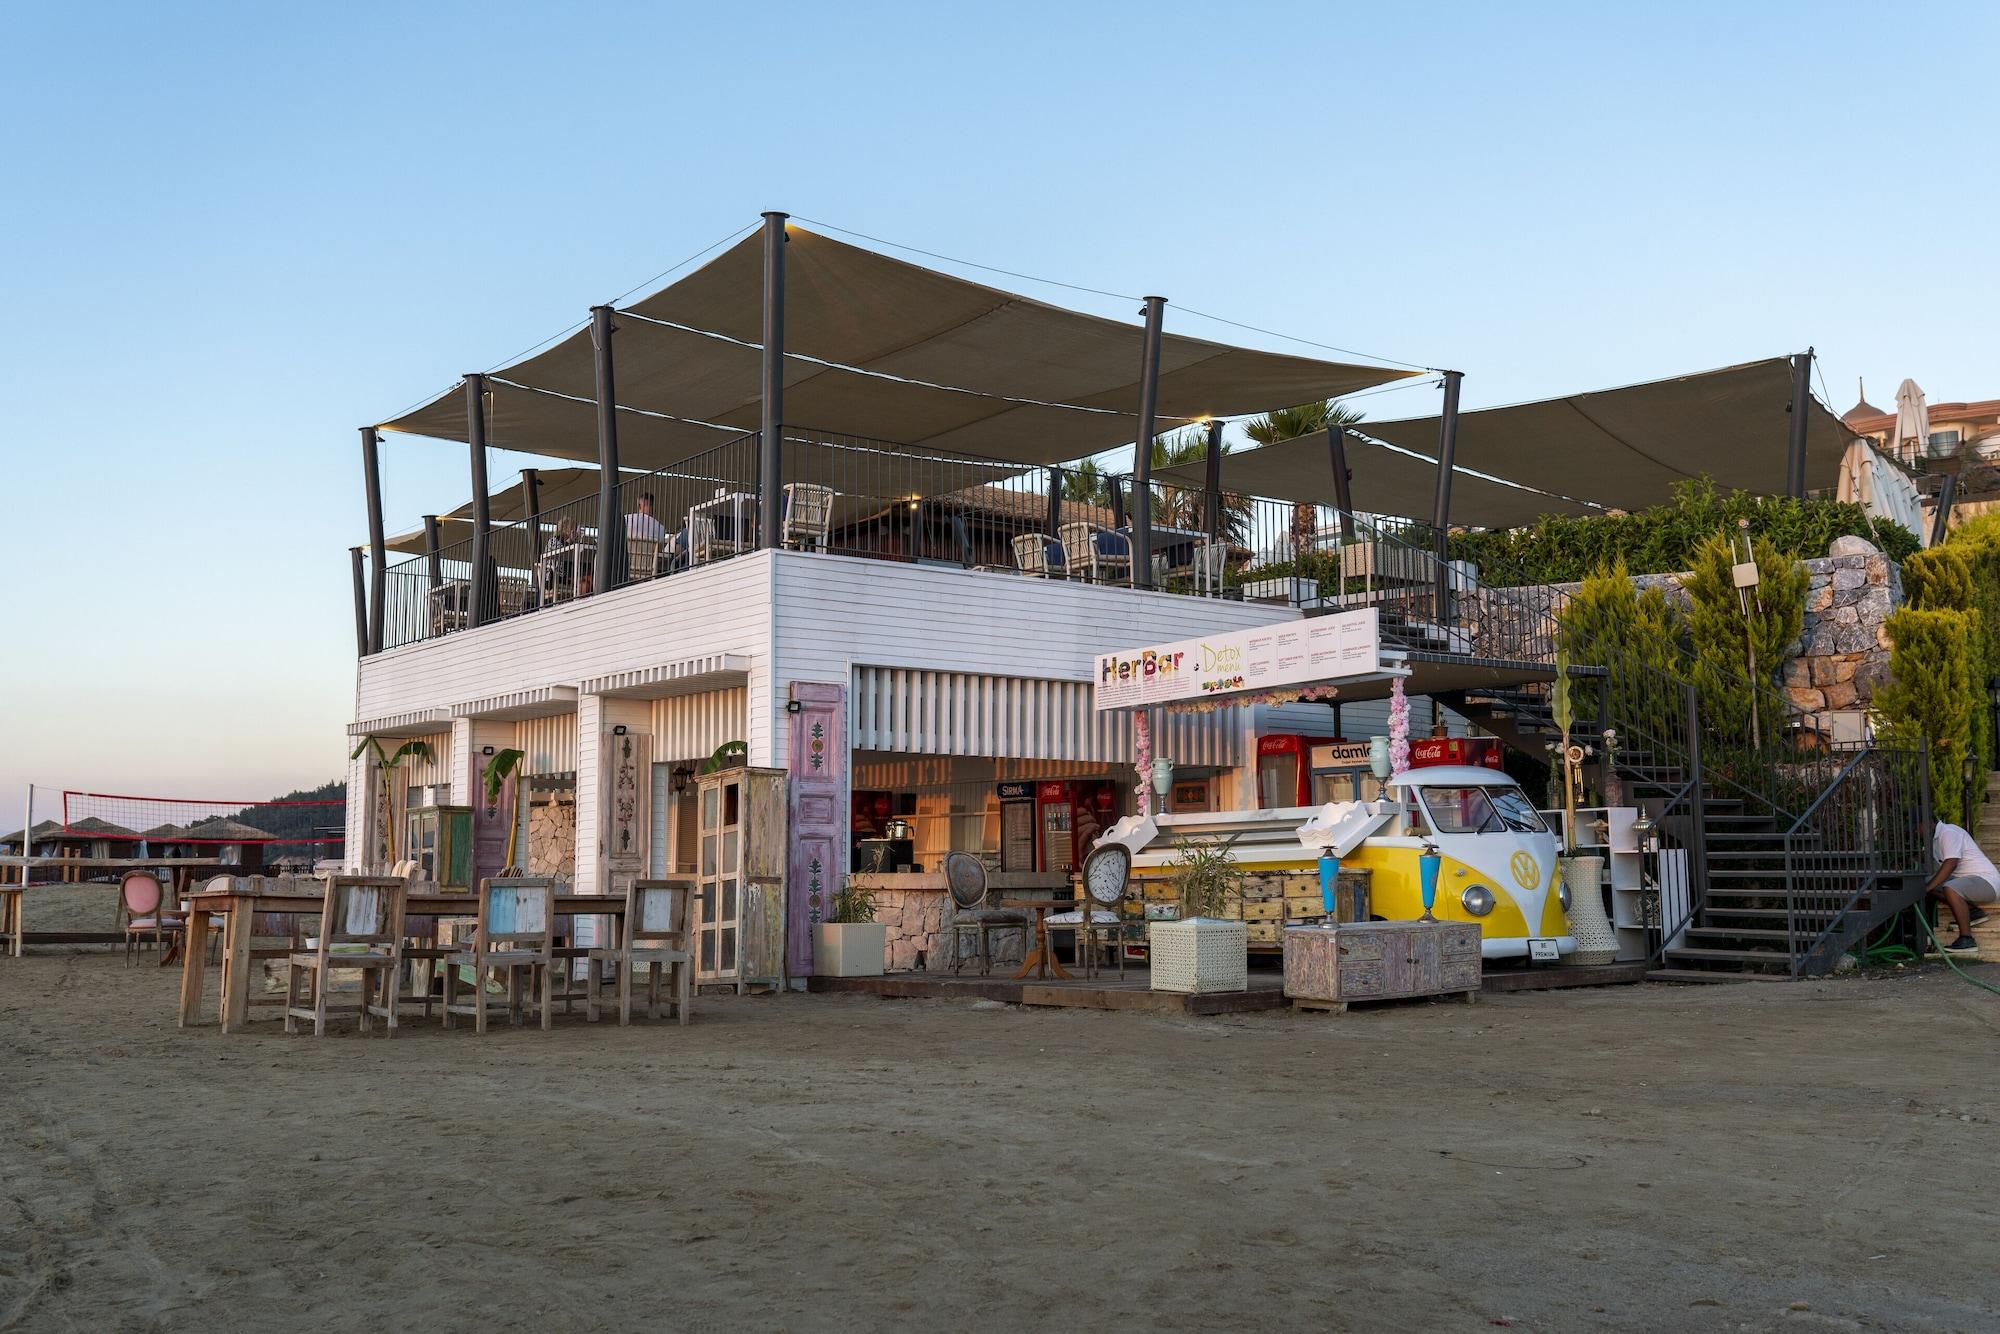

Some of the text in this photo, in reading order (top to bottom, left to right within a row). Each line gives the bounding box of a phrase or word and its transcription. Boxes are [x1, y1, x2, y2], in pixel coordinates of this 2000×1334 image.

[1102, 650, 1184, 682] HerBar
[1200, 643, 1241, 672] Detox
[1217, 662, 1241, 672] menu
